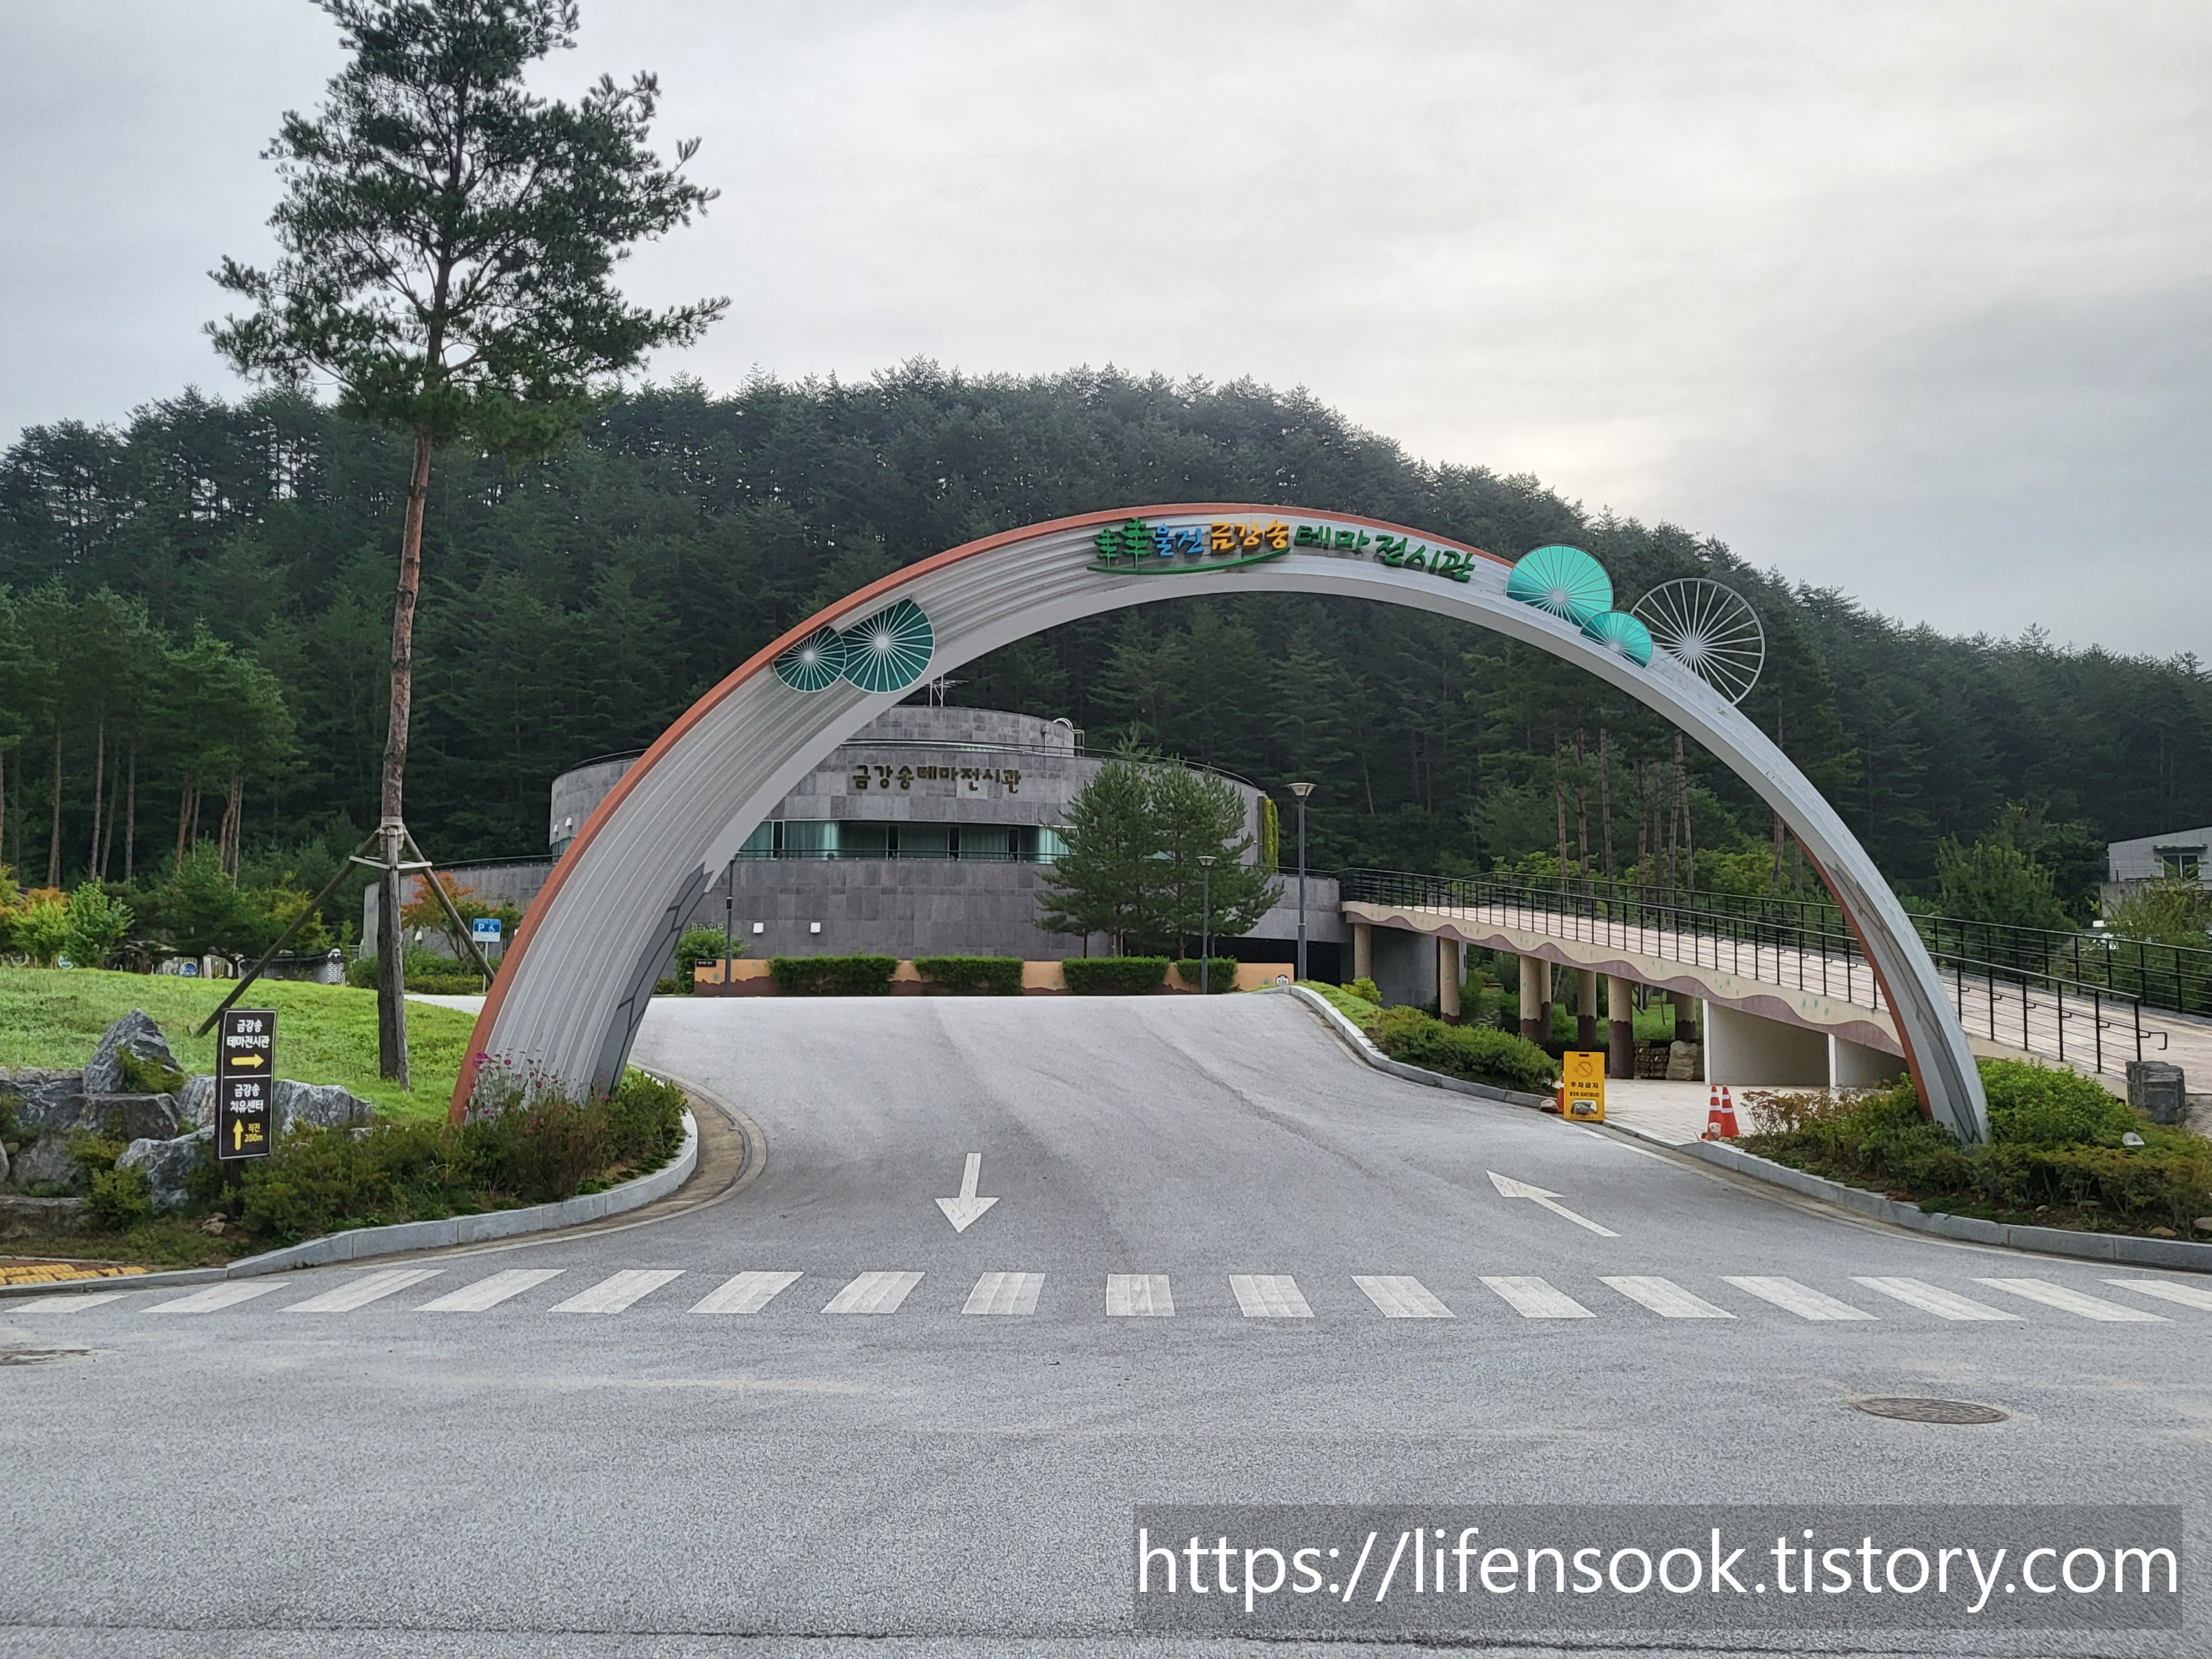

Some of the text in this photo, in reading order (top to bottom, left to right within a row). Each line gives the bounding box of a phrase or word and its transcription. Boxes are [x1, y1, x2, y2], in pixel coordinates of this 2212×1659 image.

[1154, 518, 1475, 582] 울진 금강송 테마 전시관
[853, 765, 1021, 793] 금강송테마전시관
[478, 923, 485, 932] P
[237, 1019, 263, 1032] 금강송
[226, 1035, 270, 1048] 테마전시관
[234, 1083, 261, 1097] 금강송
[229, 1099, 264, 1113] 치유센터
[248, 1123, 261, 1133] 직진
[244, 1133, 263, 1142] 200m
